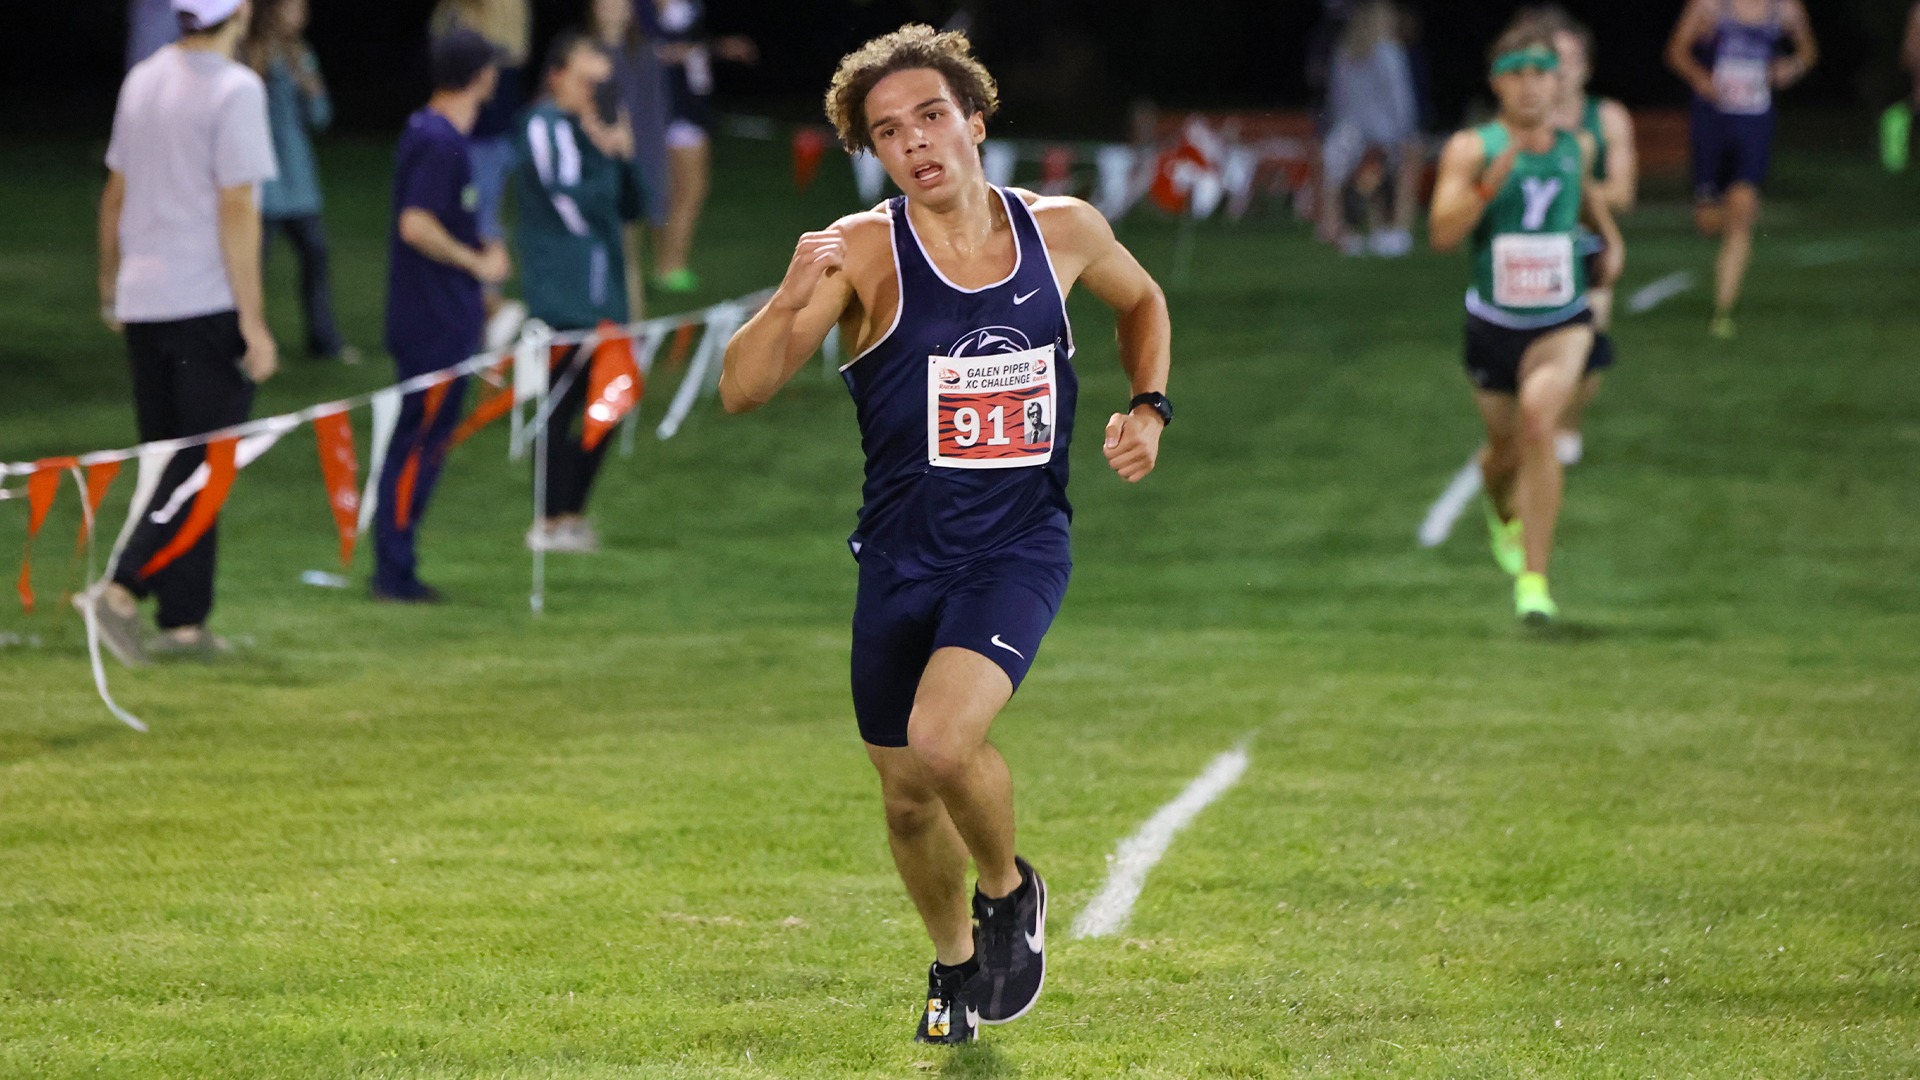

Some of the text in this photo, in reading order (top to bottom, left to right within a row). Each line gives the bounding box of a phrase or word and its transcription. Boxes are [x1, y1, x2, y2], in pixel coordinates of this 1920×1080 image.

[1521, 176, 1561, 230] Y
[965, 374, 1030, 389] XC CHALLENGE
[967, 362, 1029, 378] GALEN PIPER
[953, 406, 1010, 446] 91
